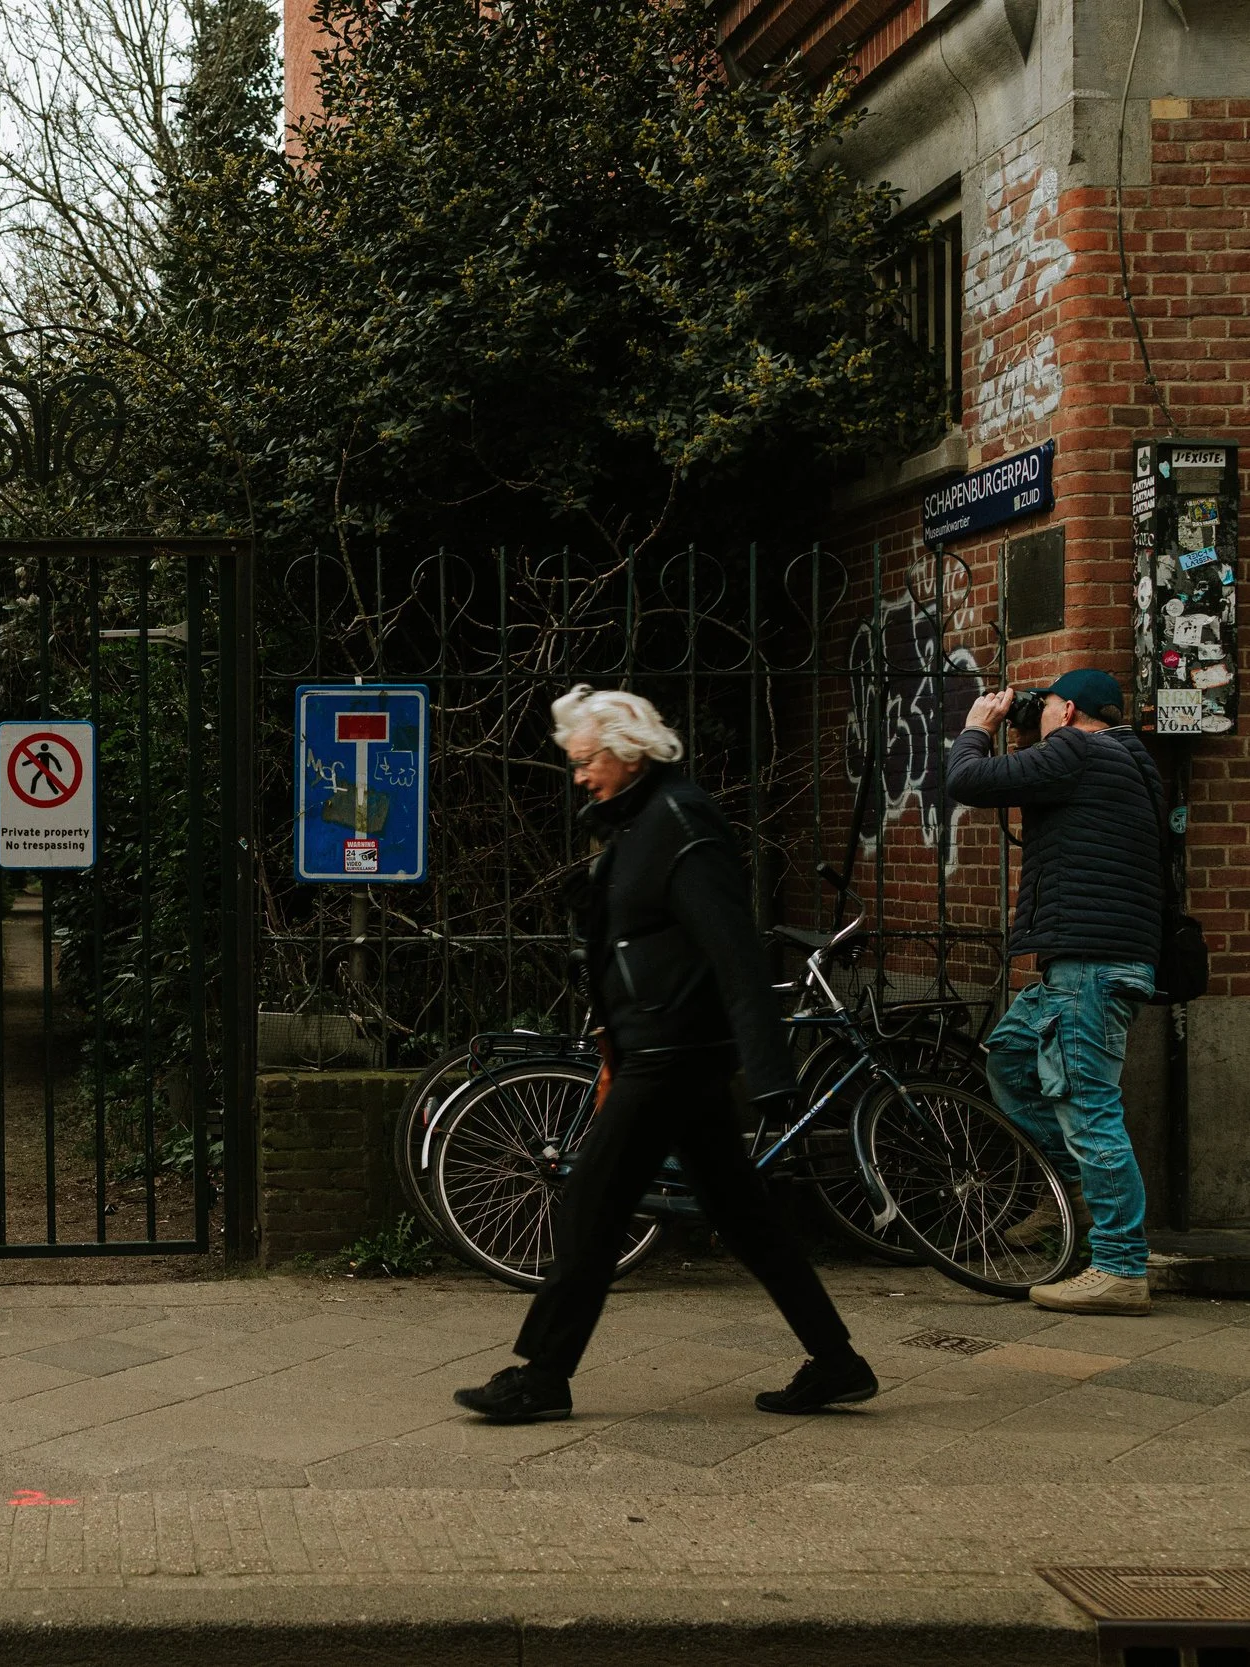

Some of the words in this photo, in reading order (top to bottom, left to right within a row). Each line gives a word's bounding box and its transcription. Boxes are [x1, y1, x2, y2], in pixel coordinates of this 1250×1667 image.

[1174, 451, 1223, 464] J'EXISTE.
[924, 454, 1040, 519] SCHAPENBURGERPAD
[1020, 487, 1040, 508] ZUID
[924, 515, 971, 542] Museumkwartier
[1158, 705, 1198, 718] NEW
[1, 828, 40, 836] Private
[44, 828, 90, 838] property
[6, 841, 19, 850] No
[23, 841, 85, 852] trespassing
